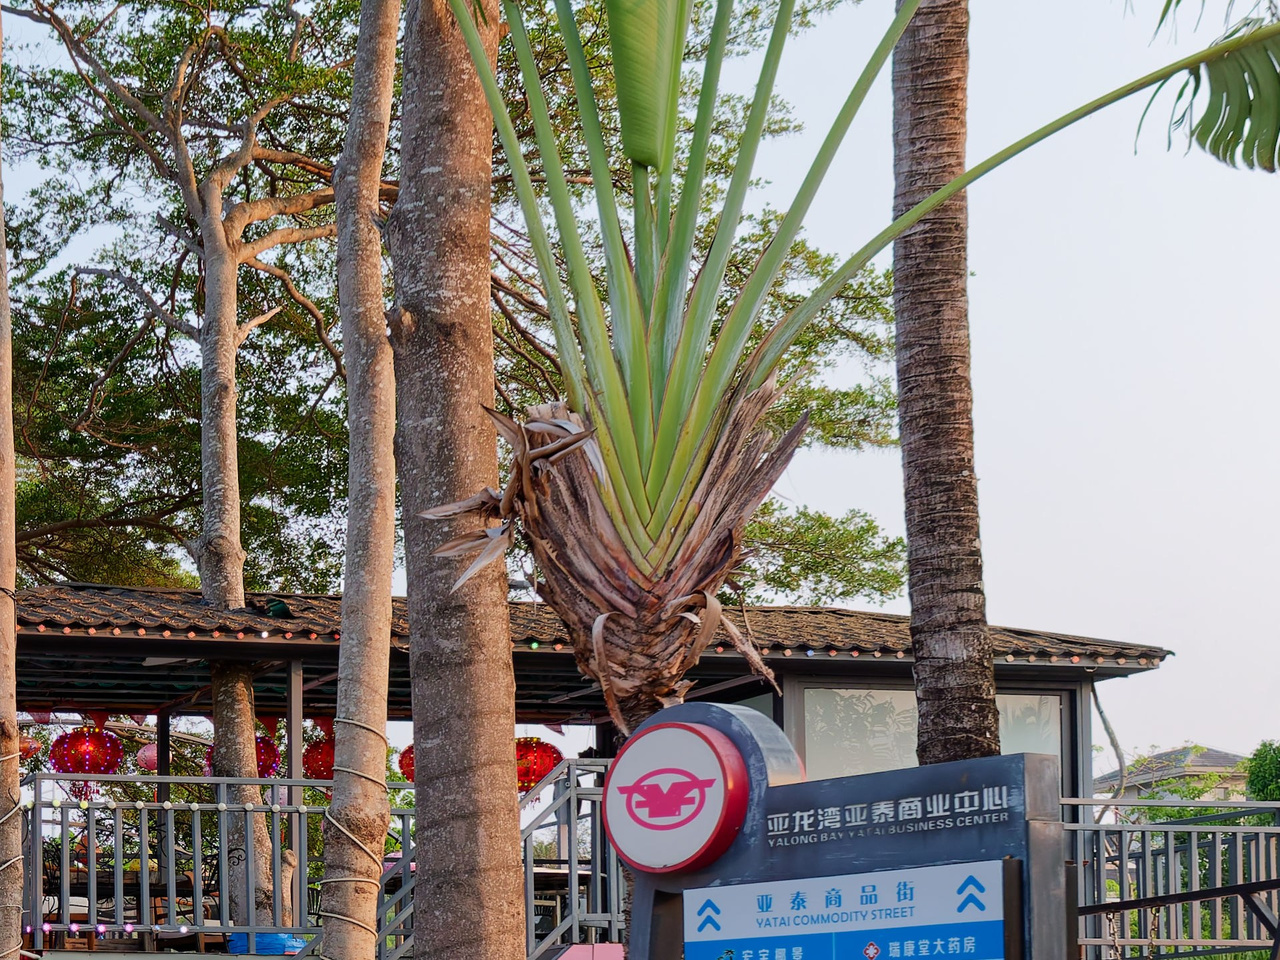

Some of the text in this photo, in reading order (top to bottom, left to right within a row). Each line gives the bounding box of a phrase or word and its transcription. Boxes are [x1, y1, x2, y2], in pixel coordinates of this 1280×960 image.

[767, 785, 1008, 836] 亚龙湾亚泰商业中心
[768, 834, 817, 847] YALONG
[820, 831, 844, 842] BAY
[889, 818, 954, 835] BUSINESS
[956, 811, 1009, 826] CENTER
[757, 881, 915, 914] 亚泰商品街
[756, 906, 916, 928] YATAI COMMODITY STREET
[888, 936, 976, 958] 瑞康堂大药房
